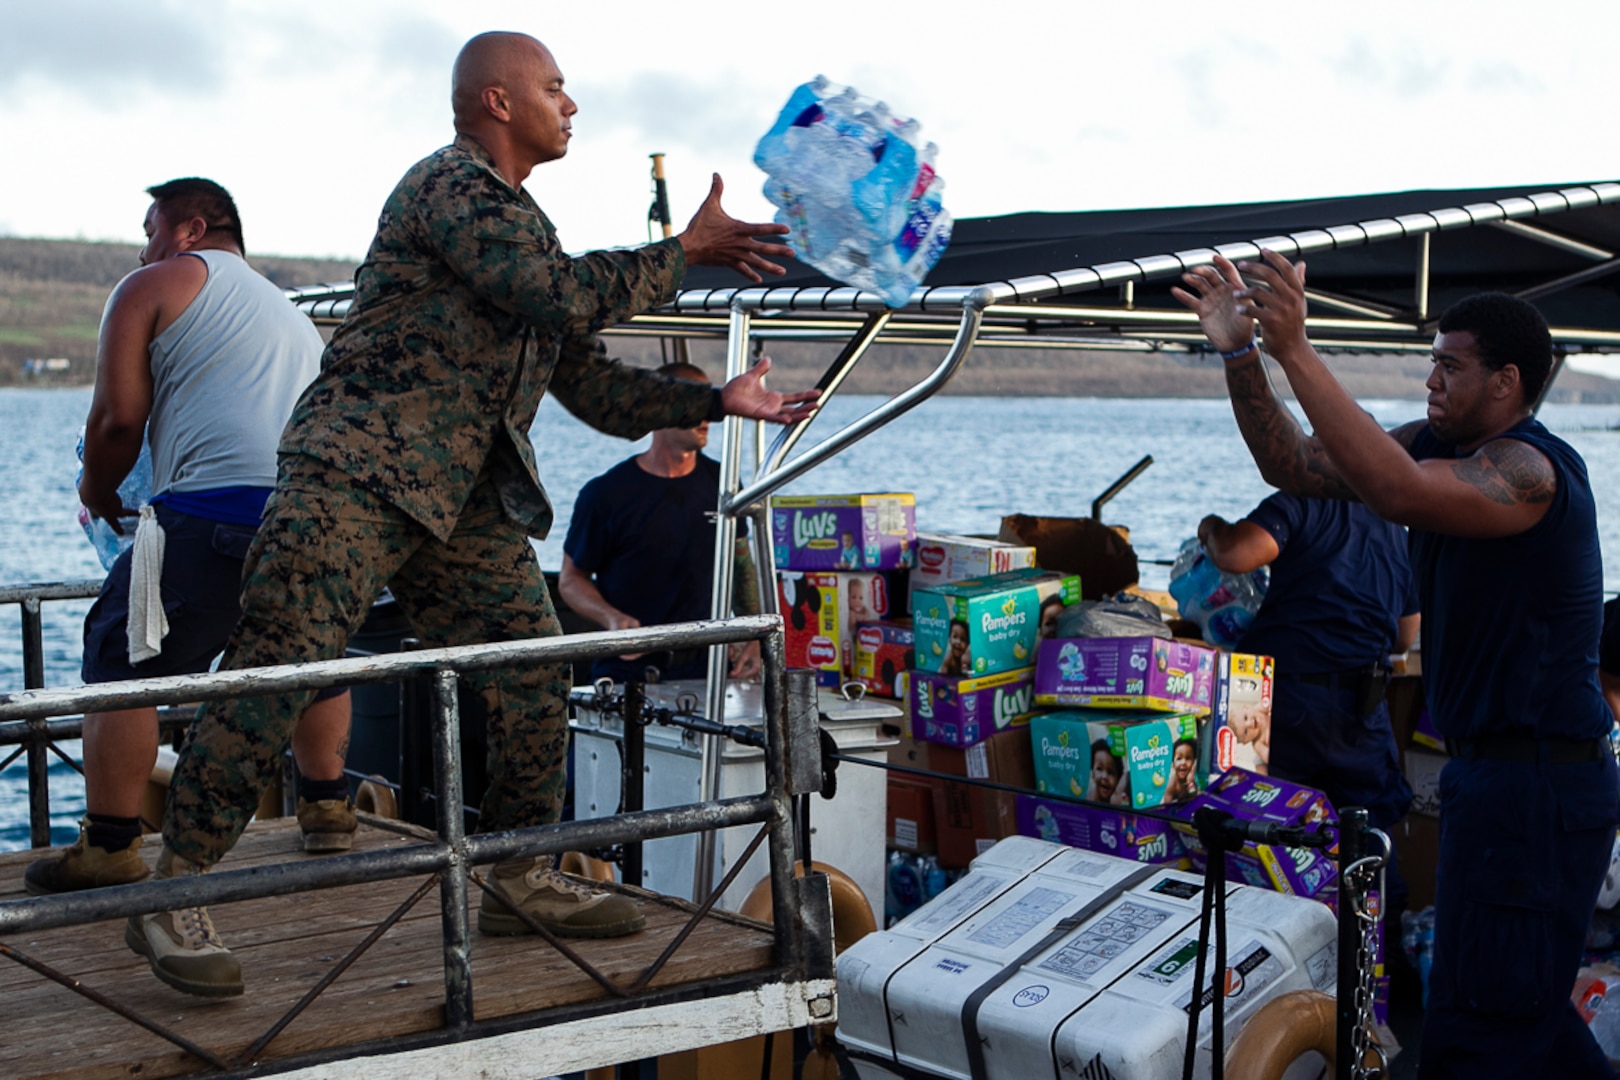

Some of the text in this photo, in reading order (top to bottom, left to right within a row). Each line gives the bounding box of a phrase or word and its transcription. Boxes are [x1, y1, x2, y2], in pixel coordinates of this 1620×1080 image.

[915, 610, 946, 629] Pampers
[982, 612, 1026, 633] Pampers
[989, 629, 1020, 642] baby dry
[977, 657, 984, 669] 3
[993, 684, 1033, 730] Luv
[1041, 737, 1080, 760] Pampers
[1131, 744, 1169, 763] Pampers
[1048, 760, 1064, 769] baby
[1137, 759, 1165, 770] baby dry
[1241, 950, 1267, 972] ZODIAC
